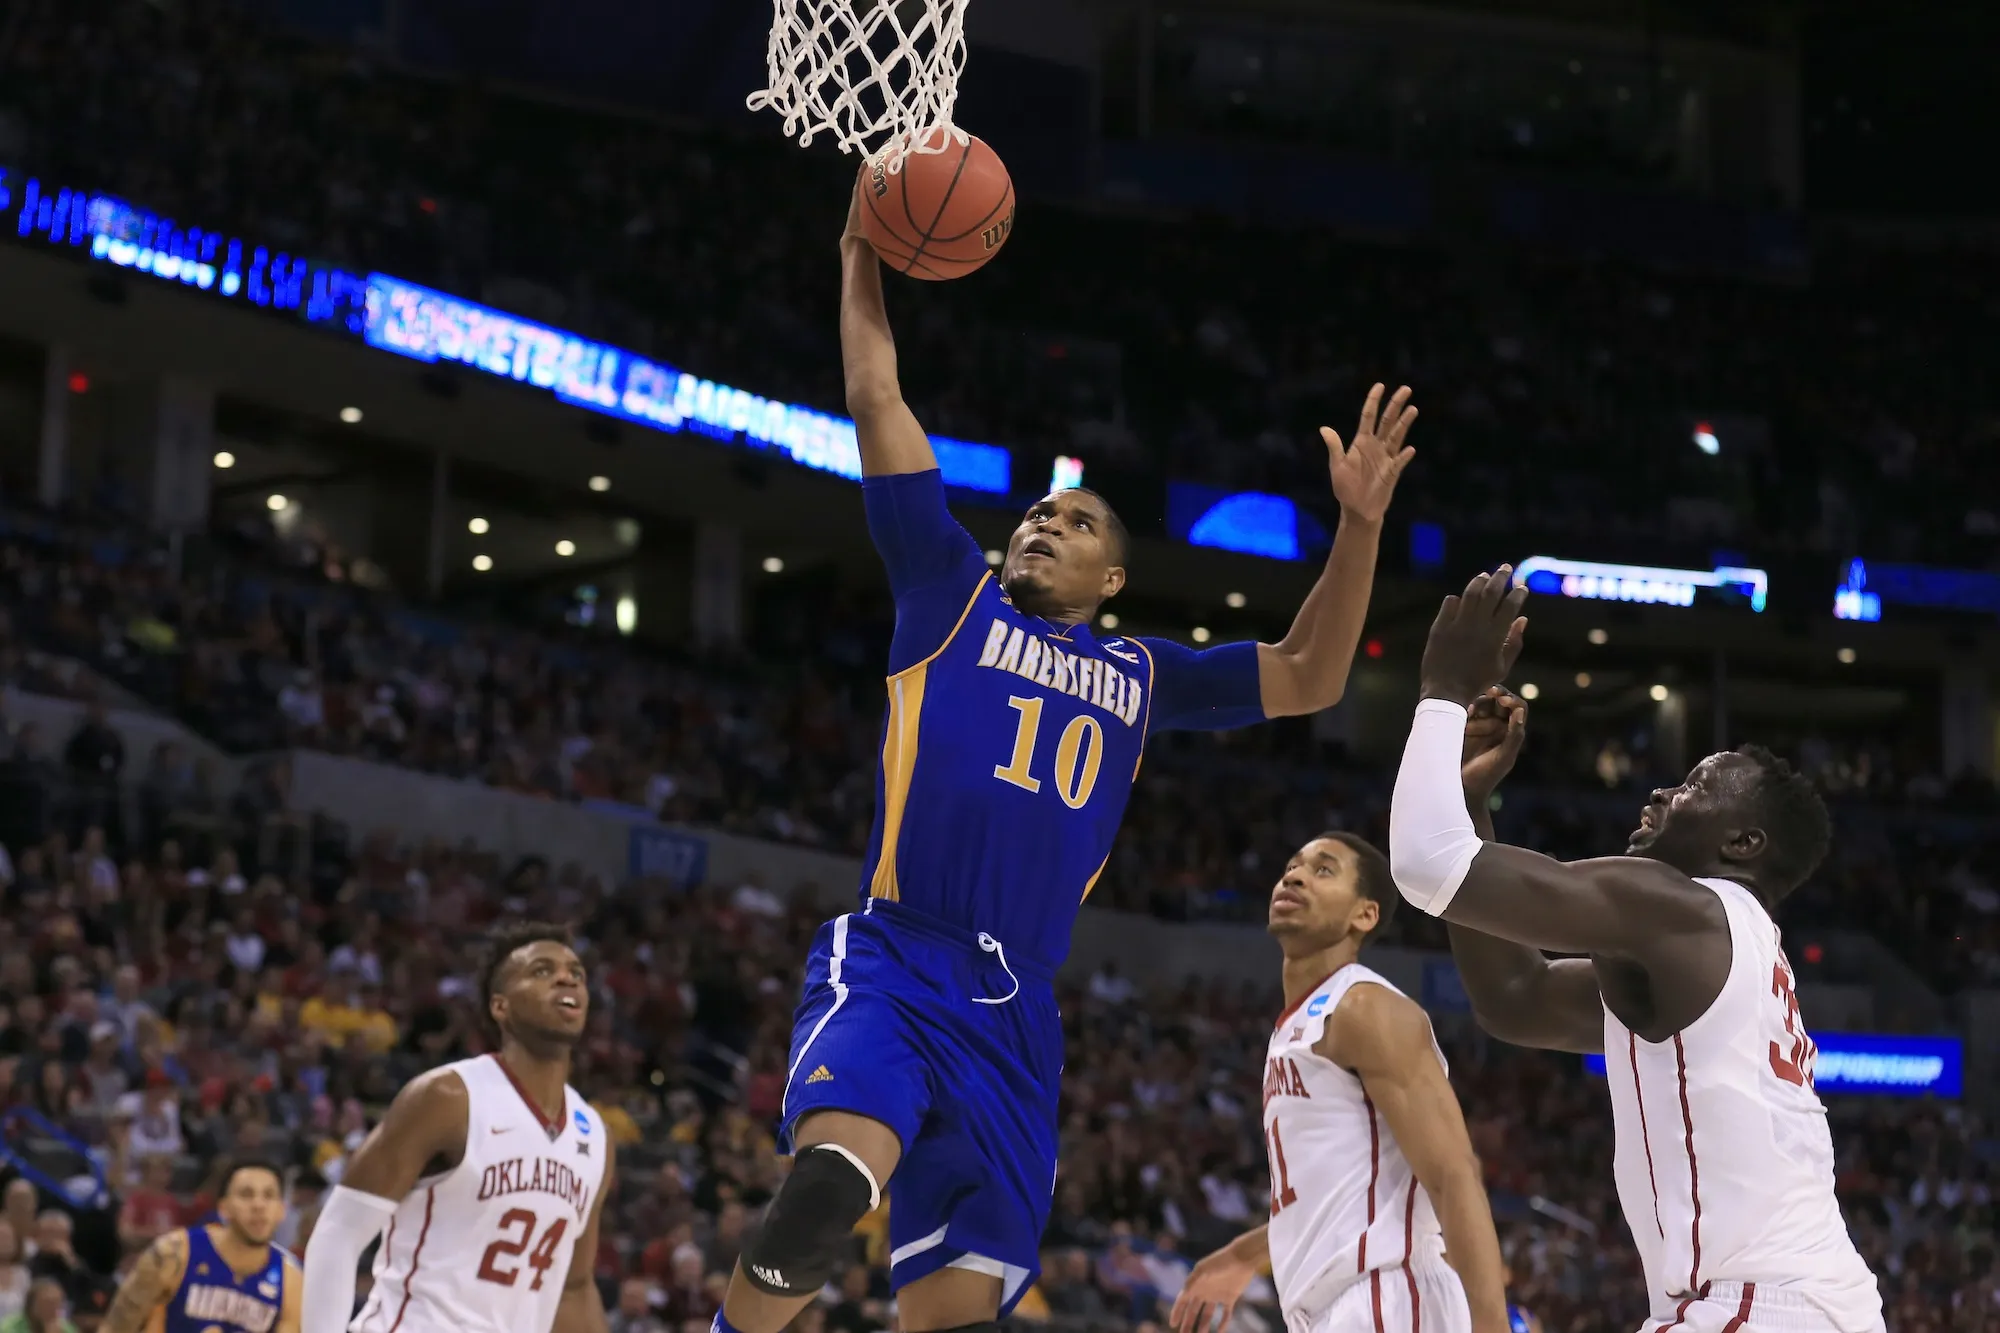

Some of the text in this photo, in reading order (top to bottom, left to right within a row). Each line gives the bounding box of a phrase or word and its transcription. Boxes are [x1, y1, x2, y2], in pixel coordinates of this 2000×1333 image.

[993, 695, 1104, 810] 10
[1266, 1115, 1297, 1217] 11
[477, 1207, 568, 1291] 24
